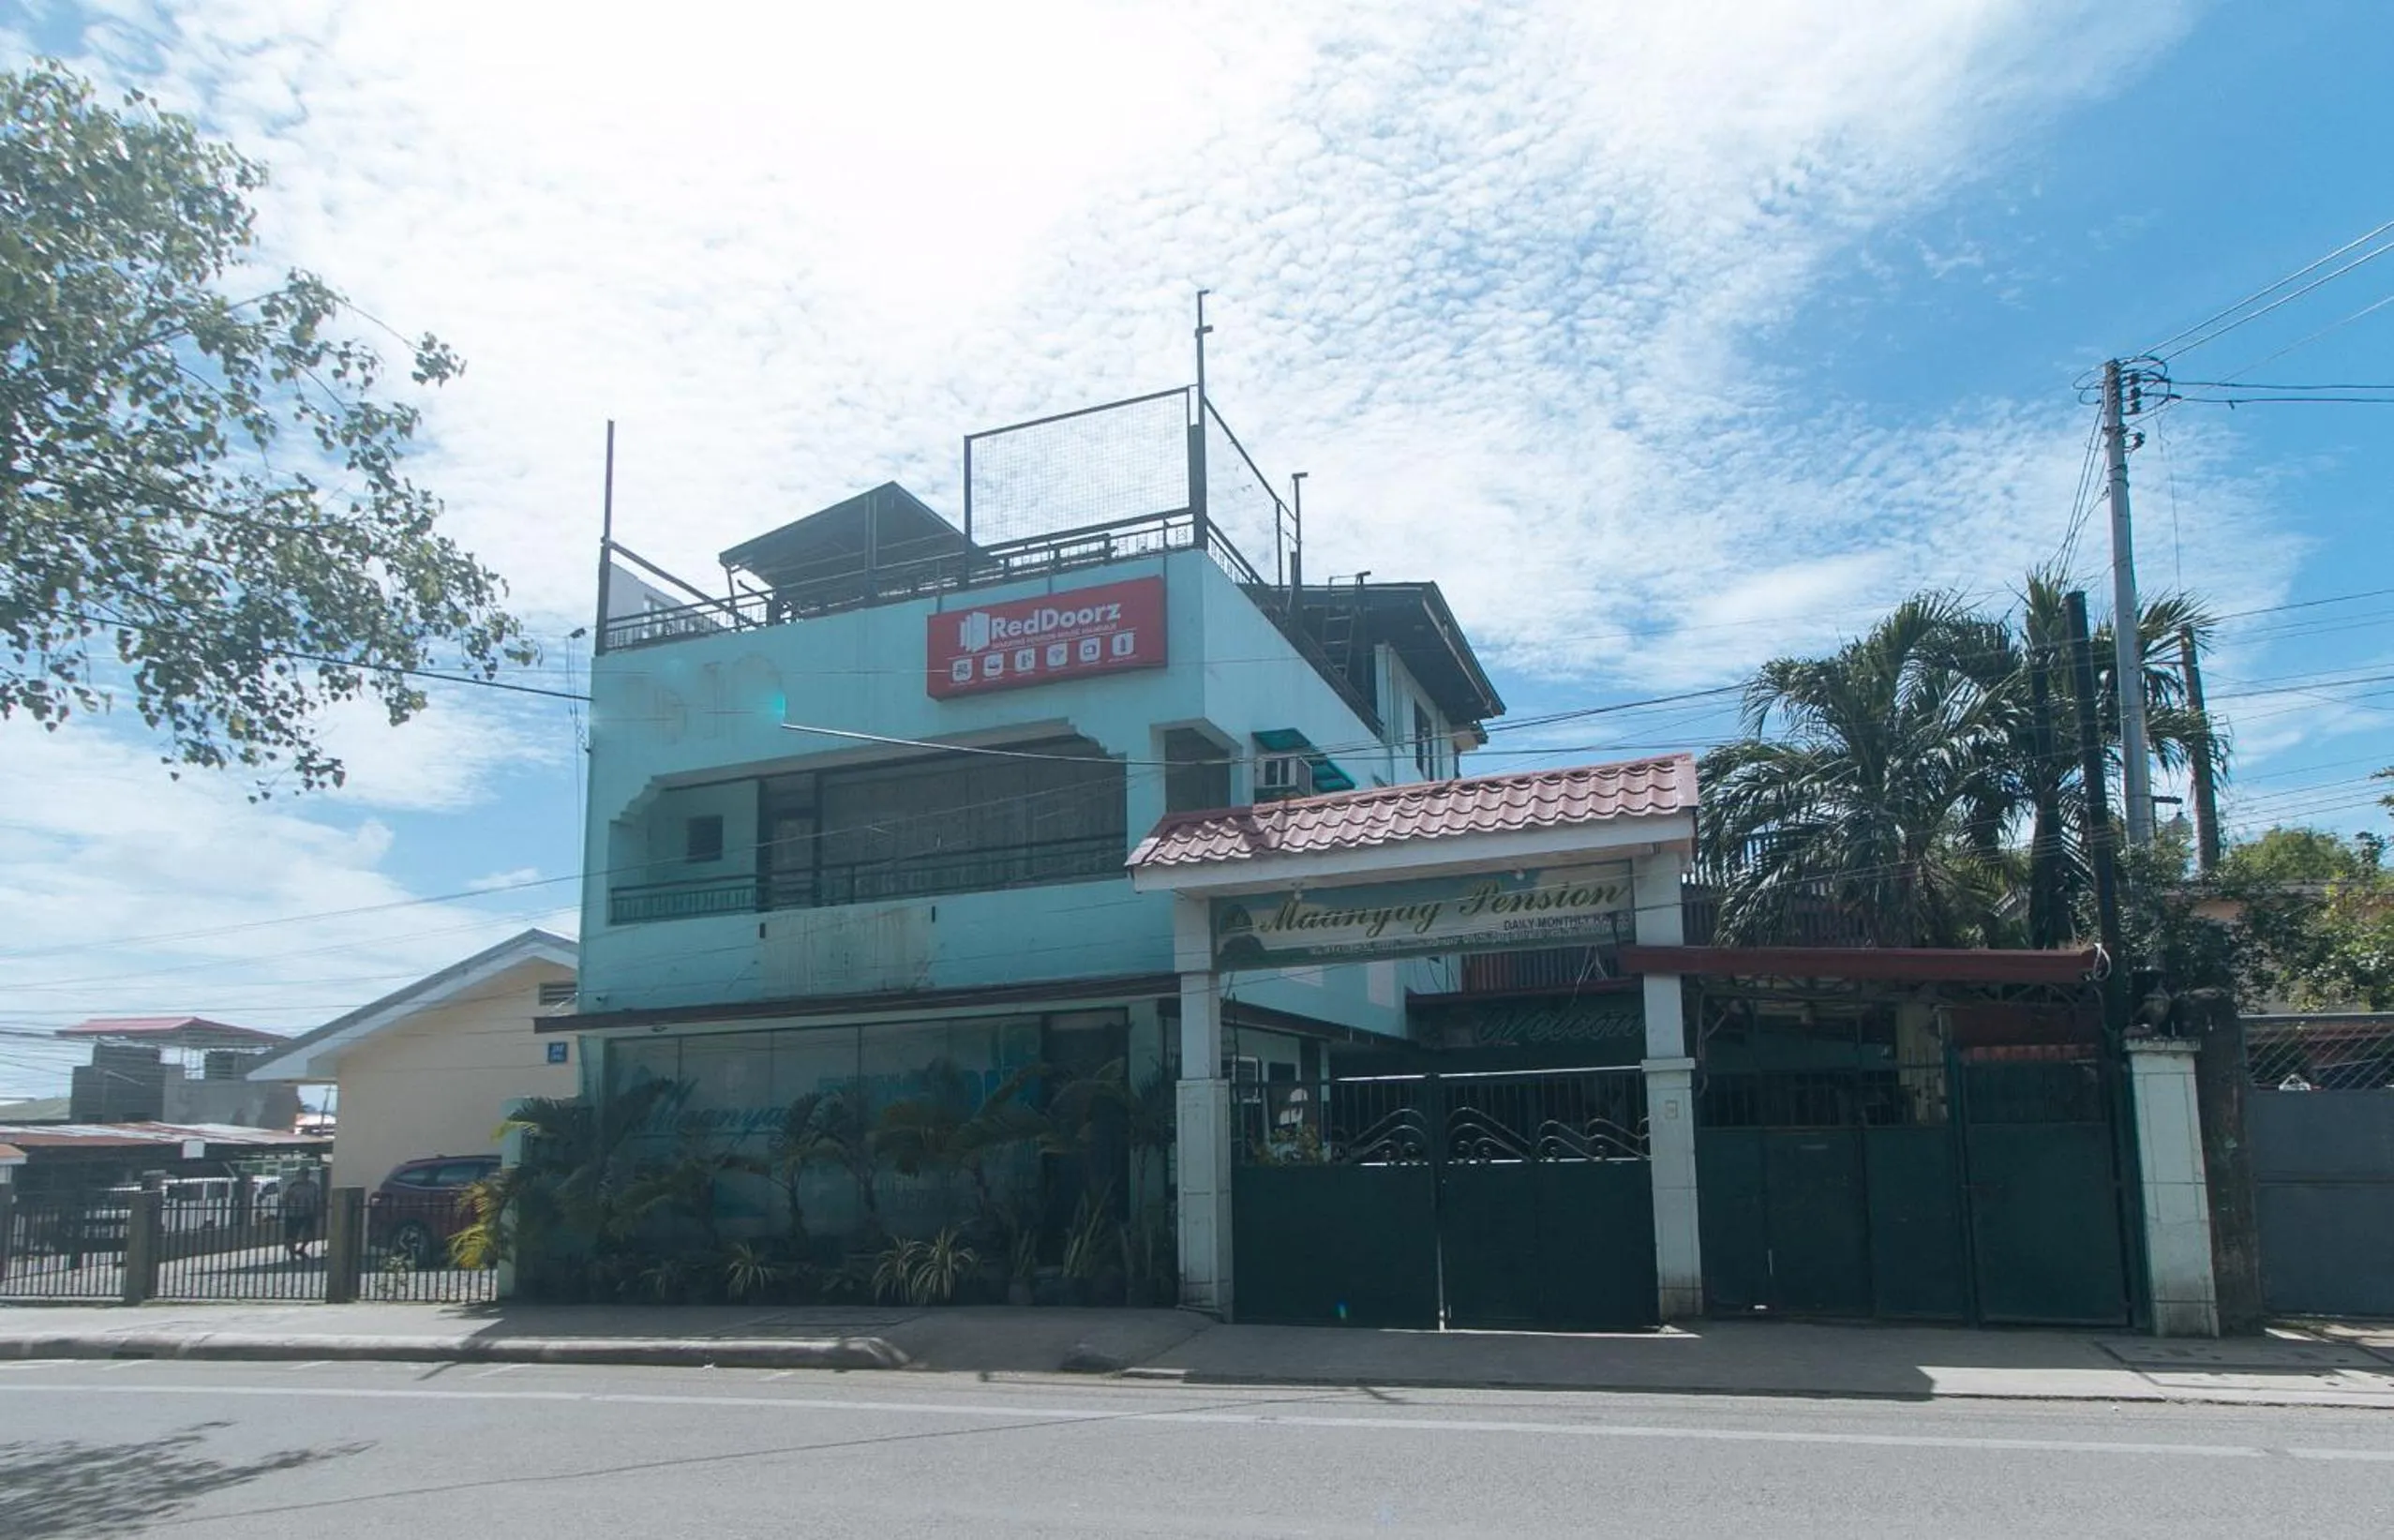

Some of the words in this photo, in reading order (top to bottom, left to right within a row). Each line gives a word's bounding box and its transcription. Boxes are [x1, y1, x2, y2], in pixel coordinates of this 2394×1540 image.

[990, 603, 1122, 639] RedDoorz
[1458, 879, 1631, 917] Pension
[1503, 918, 1535, 931] DAILY
